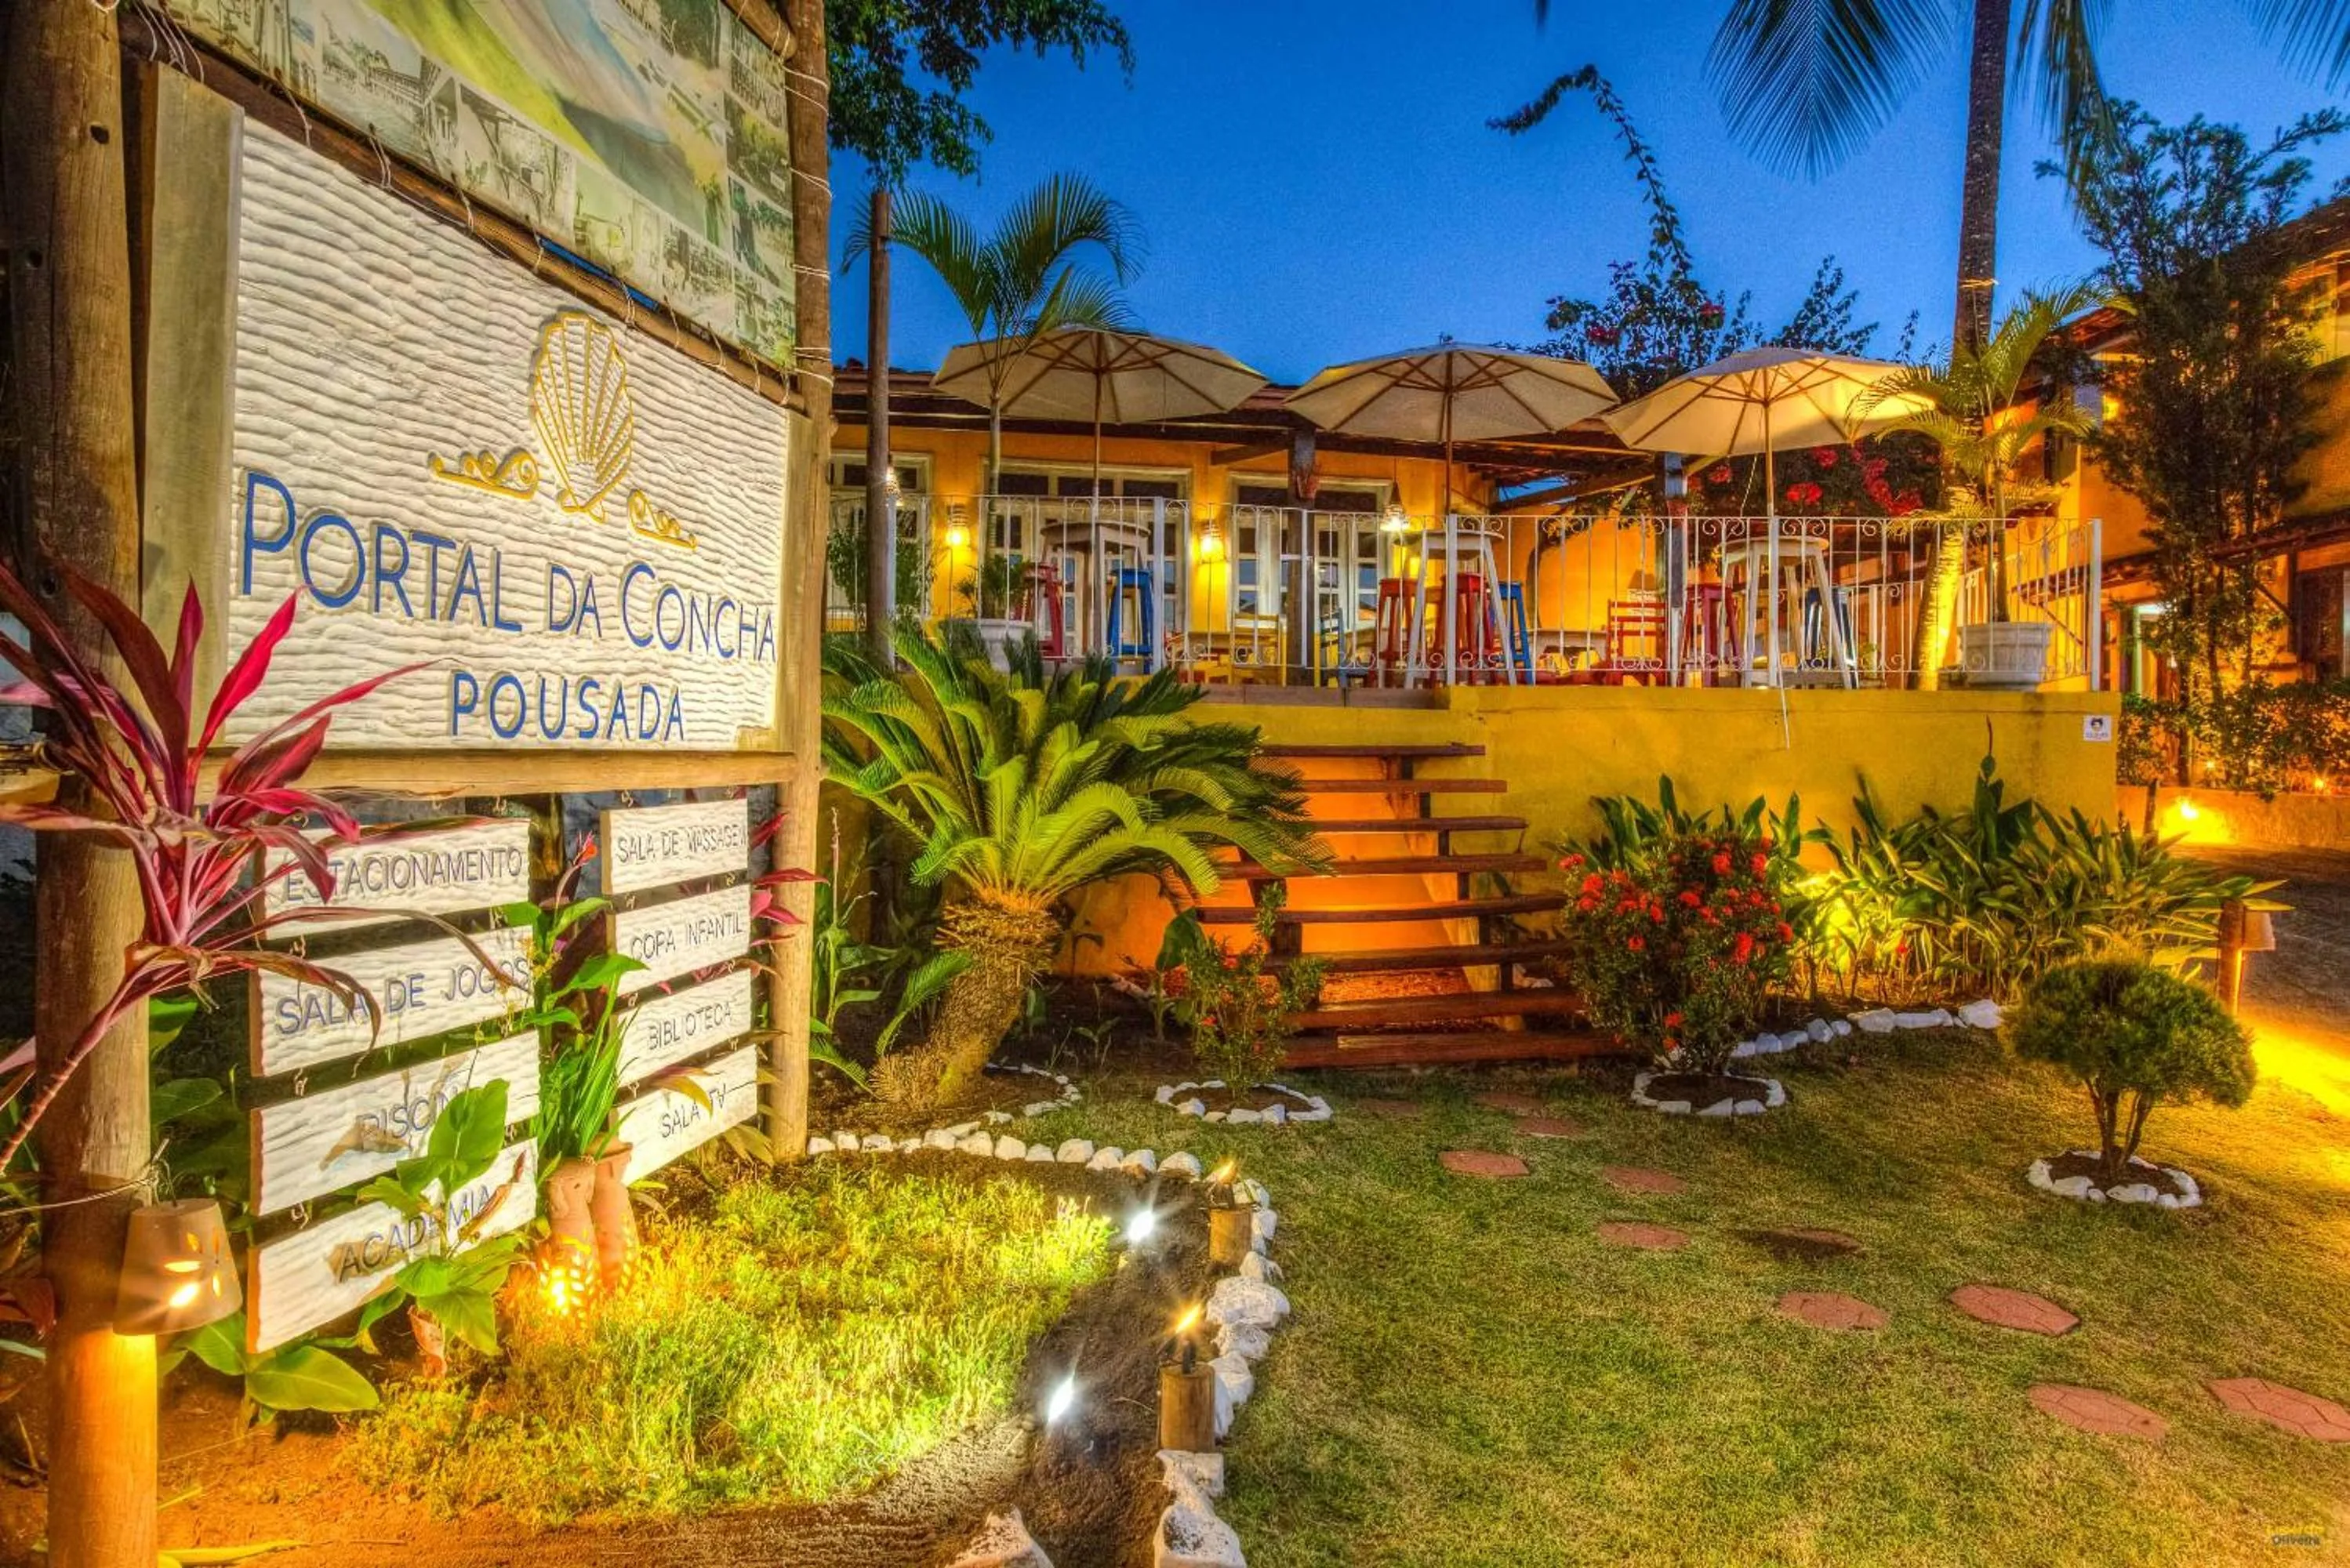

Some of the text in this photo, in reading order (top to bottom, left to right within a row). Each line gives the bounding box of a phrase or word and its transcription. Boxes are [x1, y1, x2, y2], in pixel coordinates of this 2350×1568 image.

[241, 470, 776, 662] PORTAL DA CONCHA
[452, 670, 685, 741] POUSADA
[616, 833, 655, 863] SALA
[661, 830, 680, 856] DE
[630, 912, 743, 960] COPA INFANTIL
[275, 991, 369, 1035] SALA
[385, 973, 427, 1013] DE
[661, 1083, 728, 1138] SALA TV
